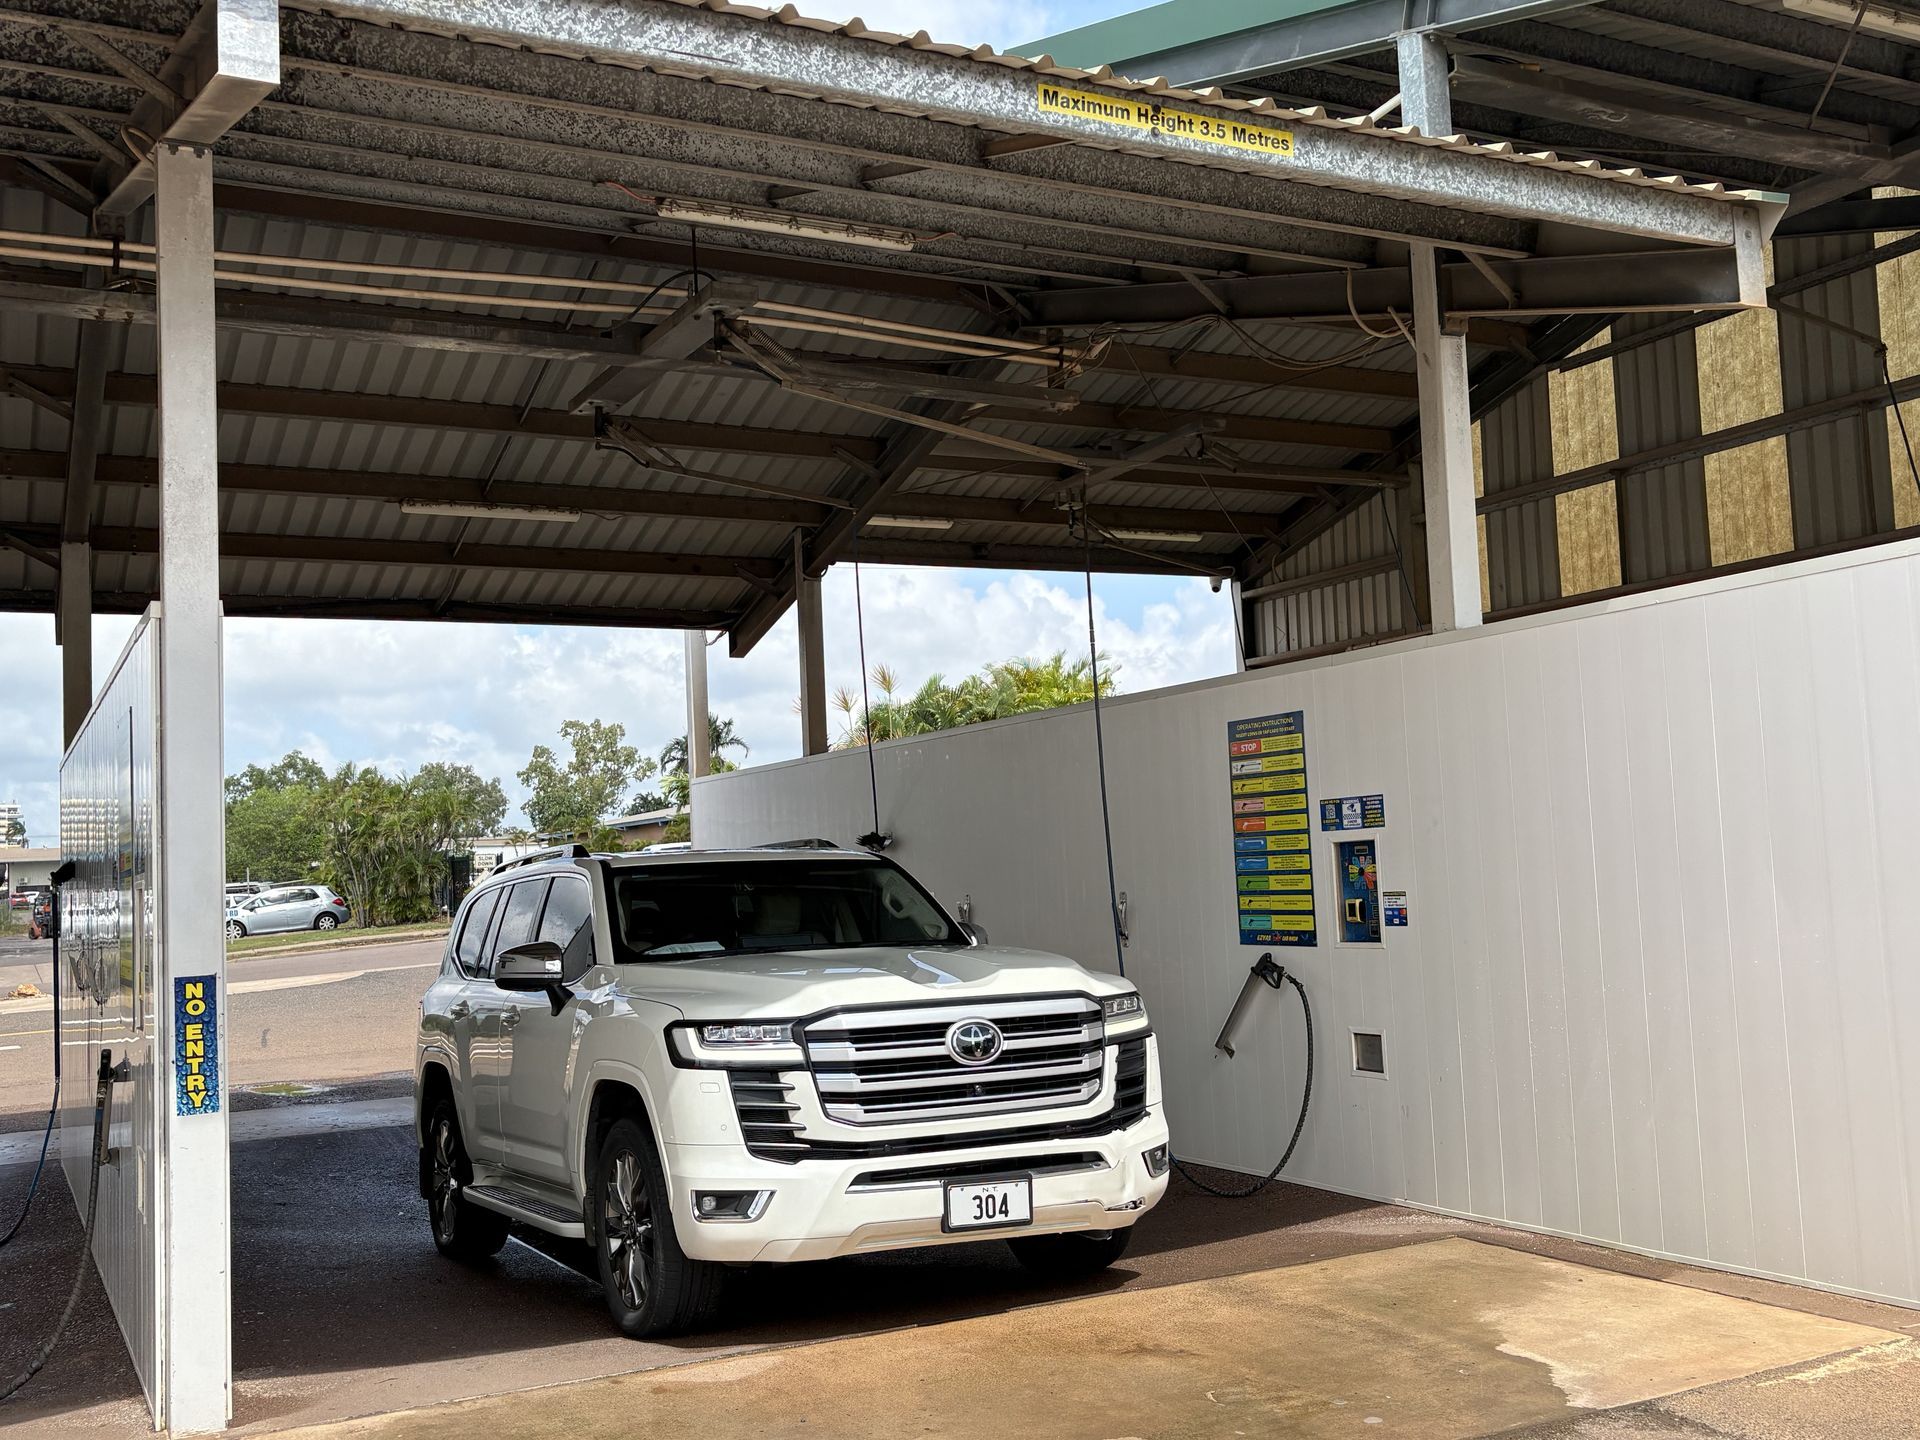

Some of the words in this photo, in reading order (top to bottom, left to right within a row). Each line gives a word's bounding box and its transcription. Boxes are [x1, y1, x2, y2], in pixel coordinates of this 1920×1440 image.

[1042, 88, 1131, 121] Maximum
[1137, 107, 1195, 134] Height
[1200, 120, 1226, 139] 3.5
[1232, 126, 1290, 151] Metres
[1240, 743, 1256, 752] STOP
[185, 982, 206, 1016] NO
[185, 1023, 208, 1108] ENTRY
[972, 1192, 1009, 1220] 304
